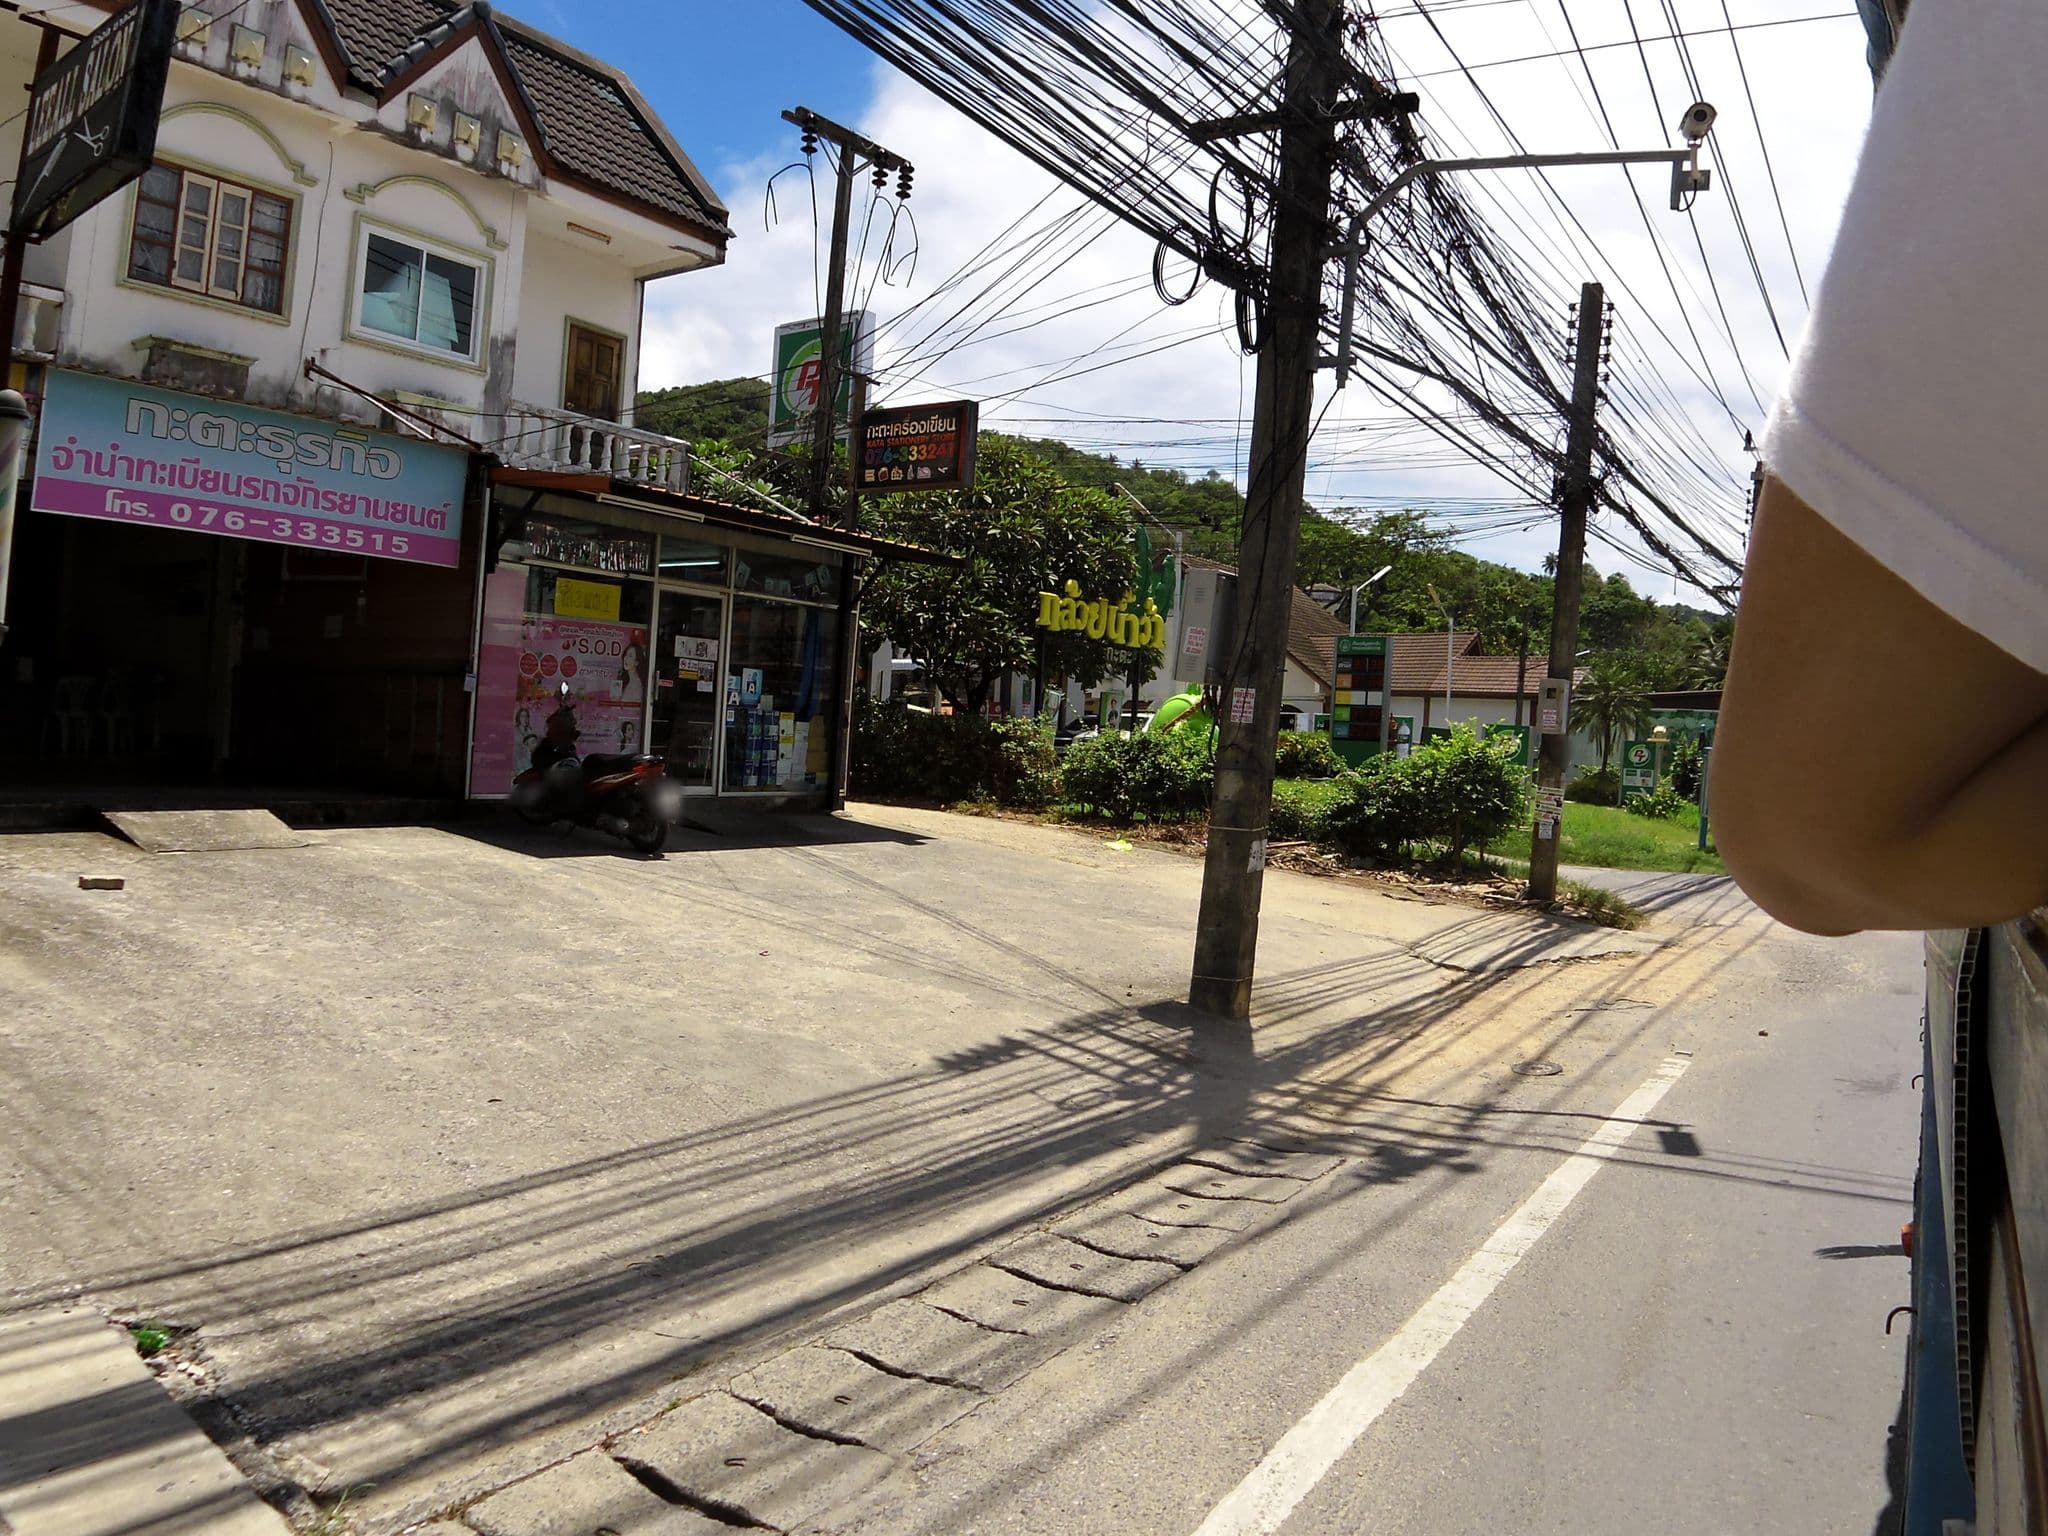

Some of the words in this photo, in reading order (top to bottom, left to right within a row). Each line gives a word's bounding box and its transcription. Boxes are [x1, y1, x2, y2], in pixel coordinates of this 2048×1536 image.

[77, 20, 136, 117] SALON
[52, 435, 453, 531] จำนำทะเบียนรถจักรยานยนต์
[124, 396, 402, 480] กะตะธุรกิจ
[105, 489, 156, 518] โทร.
[169, 502, 410, 555] 076-333515
